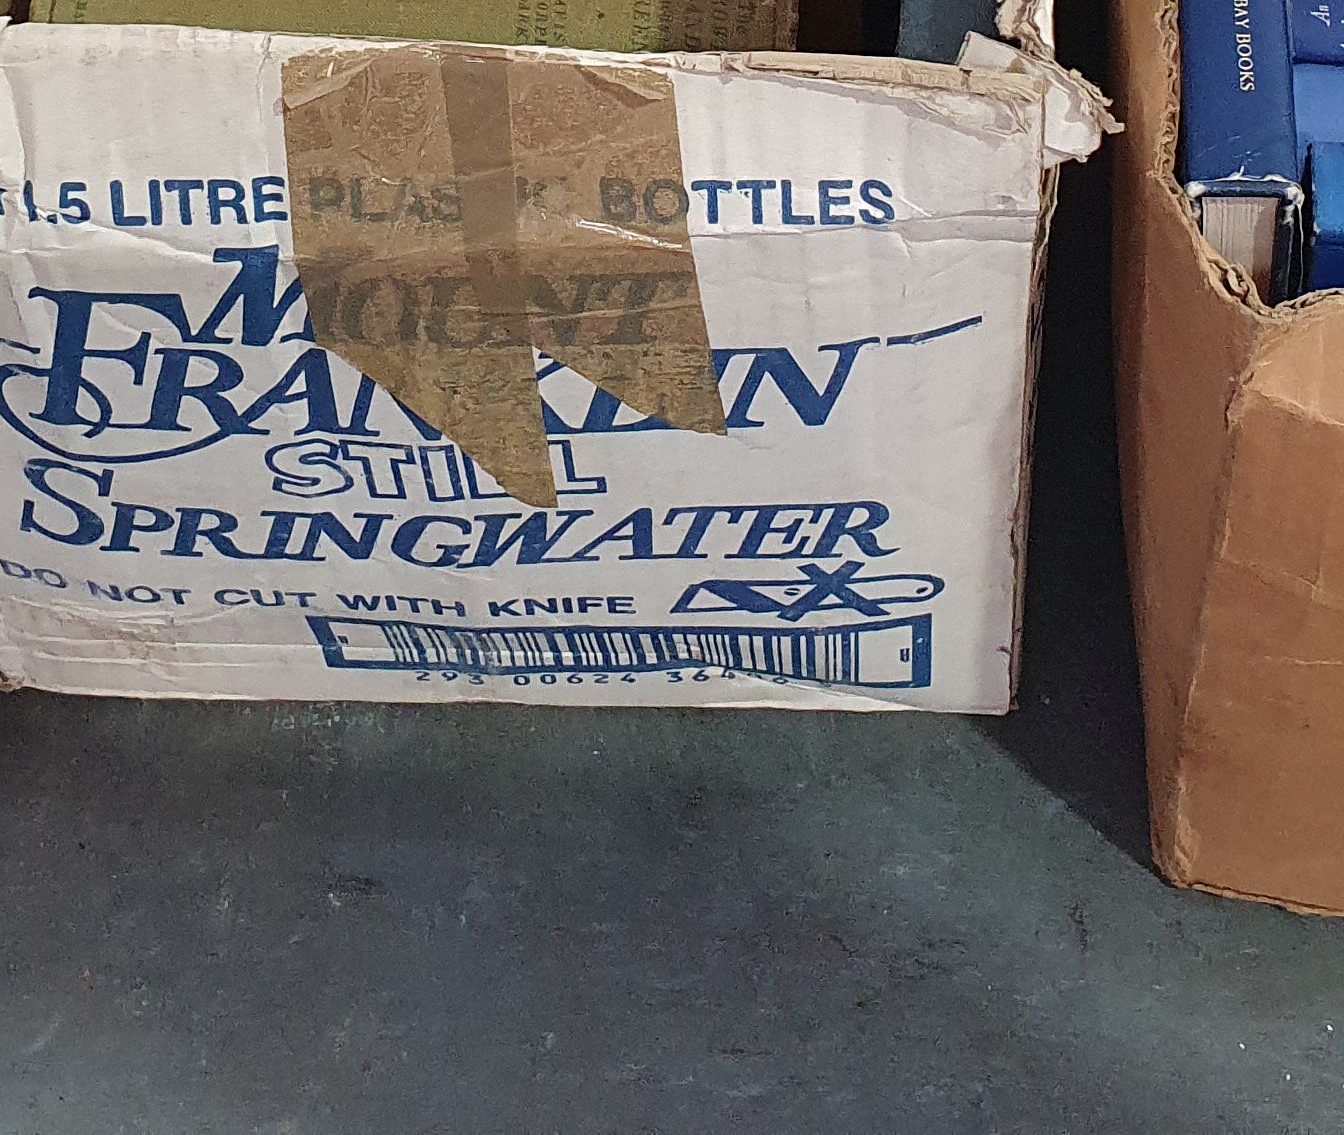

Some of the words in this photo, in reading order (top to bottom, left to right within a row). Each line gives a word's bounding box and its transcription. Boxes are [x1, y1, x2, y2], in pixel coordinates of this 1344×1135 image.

[1314, 4, 1333, 27] An
[1234, 32, 1255, 93] BOOKS
[21, 177, 92, 225] 1.5
[109, 175, 290, 227] LITRE
[598, 178, 897, 225] BOTTLES
[19, 456, 901, 568] SPRINGWATER
[86, 579, 193, 607] NOT
[213, 587, 318, 610] CUT
[334, 592, 467, 618] WITH
[487, 594, 640, 617] KNIFE
[415, 670, 487, 686] 293
[512, 673, 637, 686] 00624
